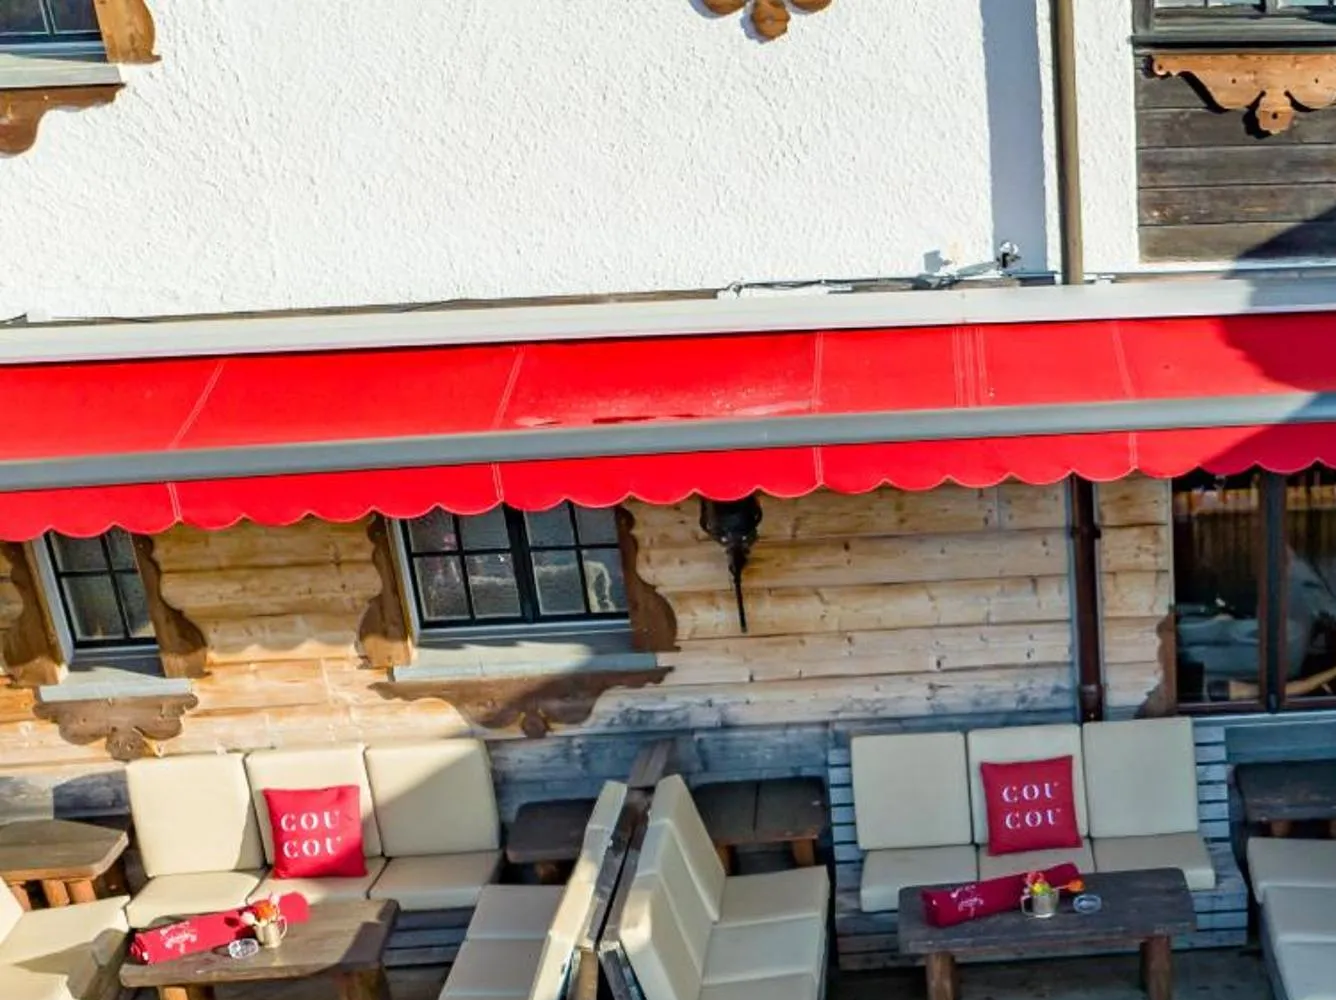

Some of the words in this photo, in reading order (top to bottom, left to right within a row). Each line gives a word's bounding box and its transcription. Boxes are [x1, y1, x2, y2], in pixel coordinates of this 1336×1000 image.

[1002, 782, 1059, 803] COU
[280, 810, 341, 832] COU
[1004, 807, 1061, 830] COU
[282, 835, 343, 858] COU
